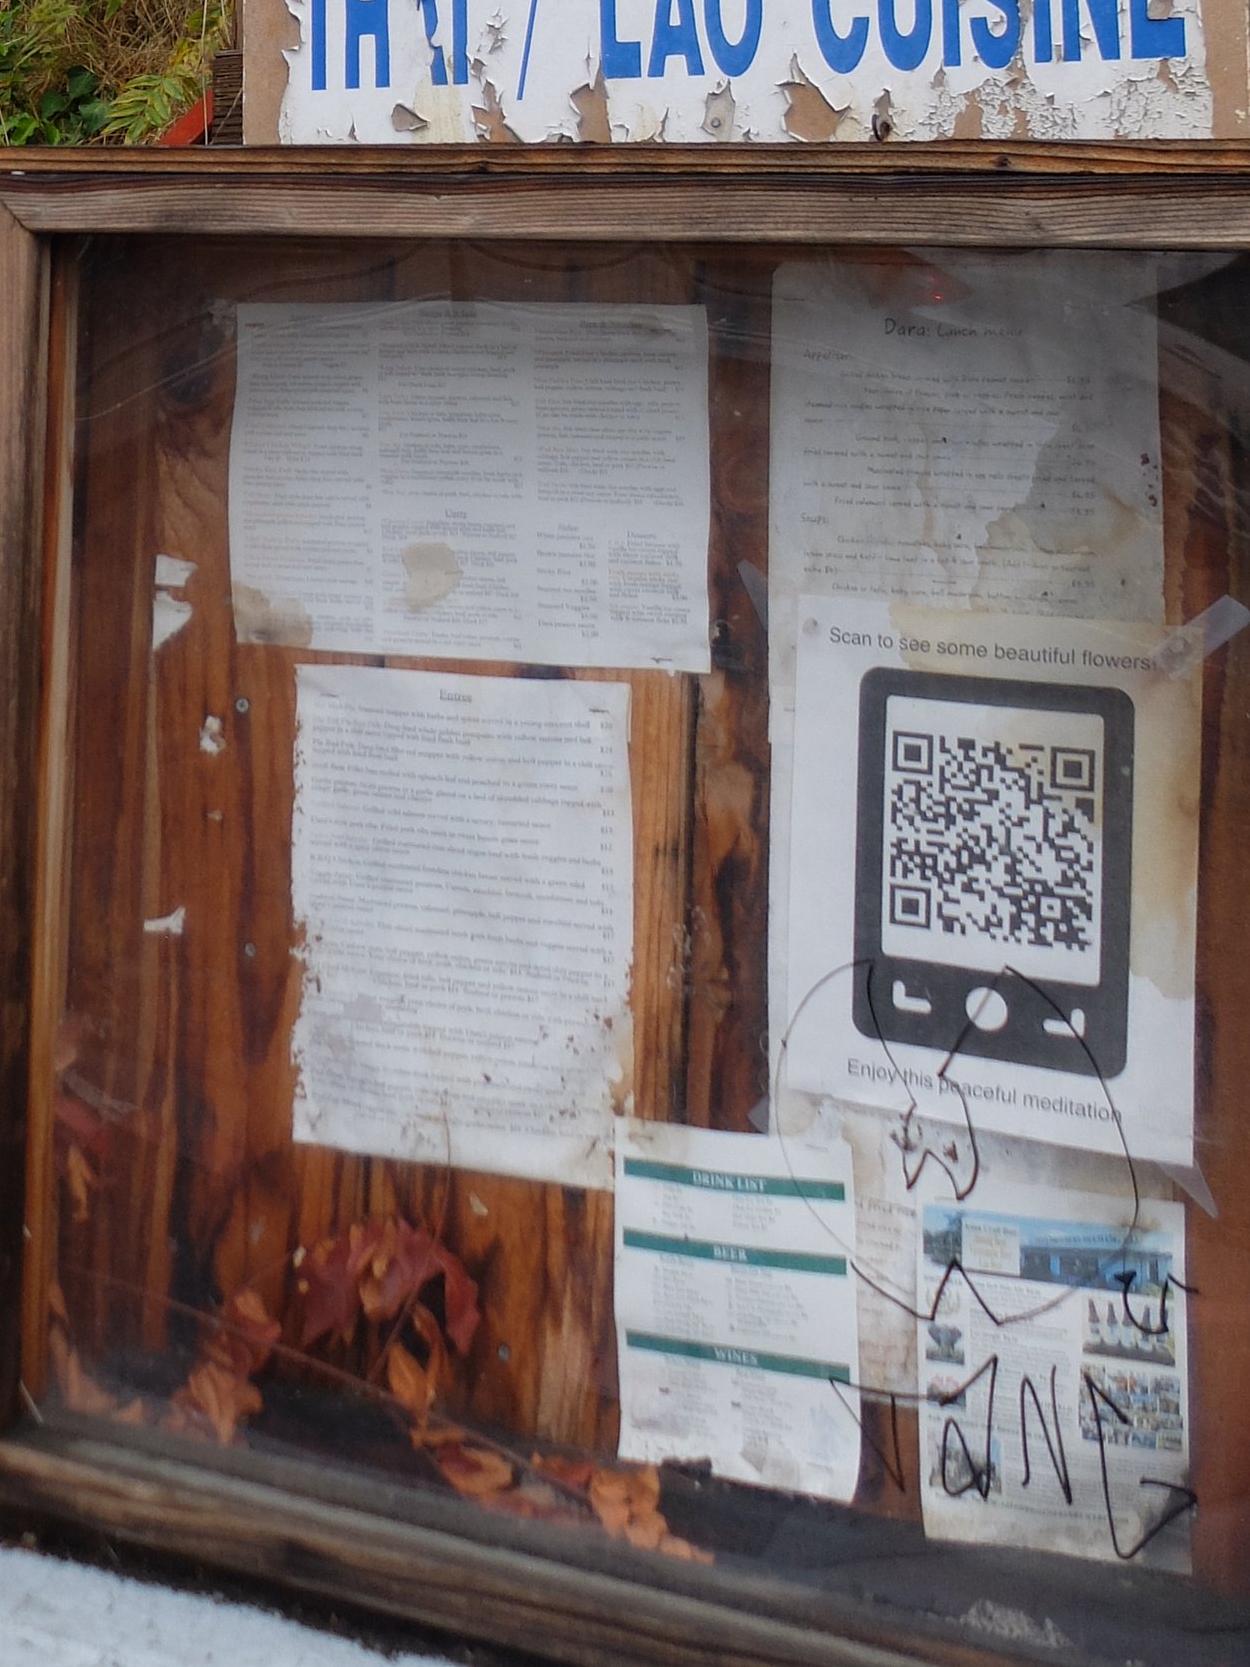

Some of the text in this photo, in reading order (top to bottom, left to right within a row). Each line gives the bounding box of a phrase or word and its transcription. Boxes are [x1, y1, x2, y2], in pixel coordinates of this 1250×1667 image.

[884, 317, 931, 335] Dara:
[936, 322, 977, 337] Lunch
[829, 627, 872, 647] Scan
[878, 633, 894, 650] to
[899, 638, 931, 654] see
[936, 642, 988, 658] some
[994, 643, 1076, 665] beautiful
[847, 1058, 1123, 1123] Enjoy this peaceful meditation
[693, 1170, 766, 1193] DRINK LIST
[713, 1245, 748, 1262] BEER
[714, 1346, 759, 1366] WINES
